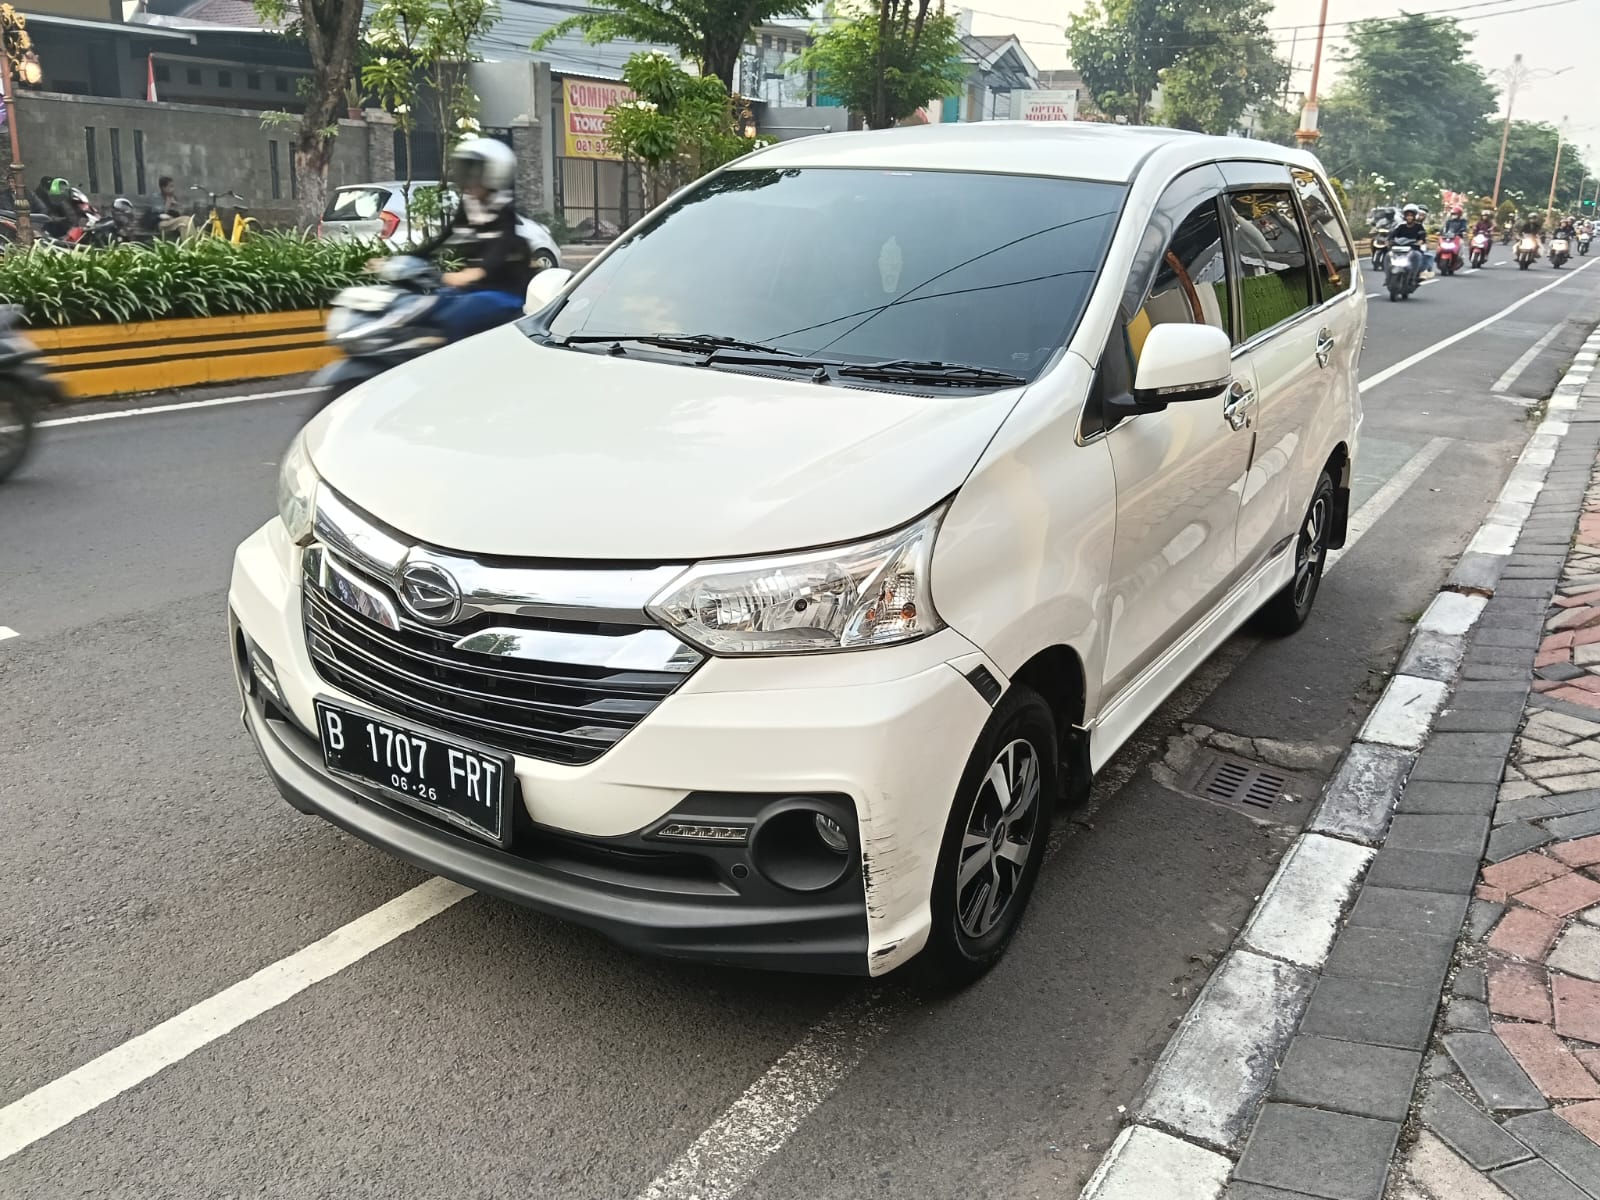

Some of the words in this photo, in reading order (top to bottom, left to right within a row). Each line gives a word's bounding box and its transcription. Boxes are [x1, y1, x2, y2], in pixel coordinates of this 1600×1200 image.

[570, 84, 617, 108] COMING
[1025, 113, 1068, 121] MODERN
[1031, 105, 1064, 113] OPTIK
[325, 711, 345, 750] B
[366, 723, 427, 779] 1707
[448, 748, 496, 807] FRT
